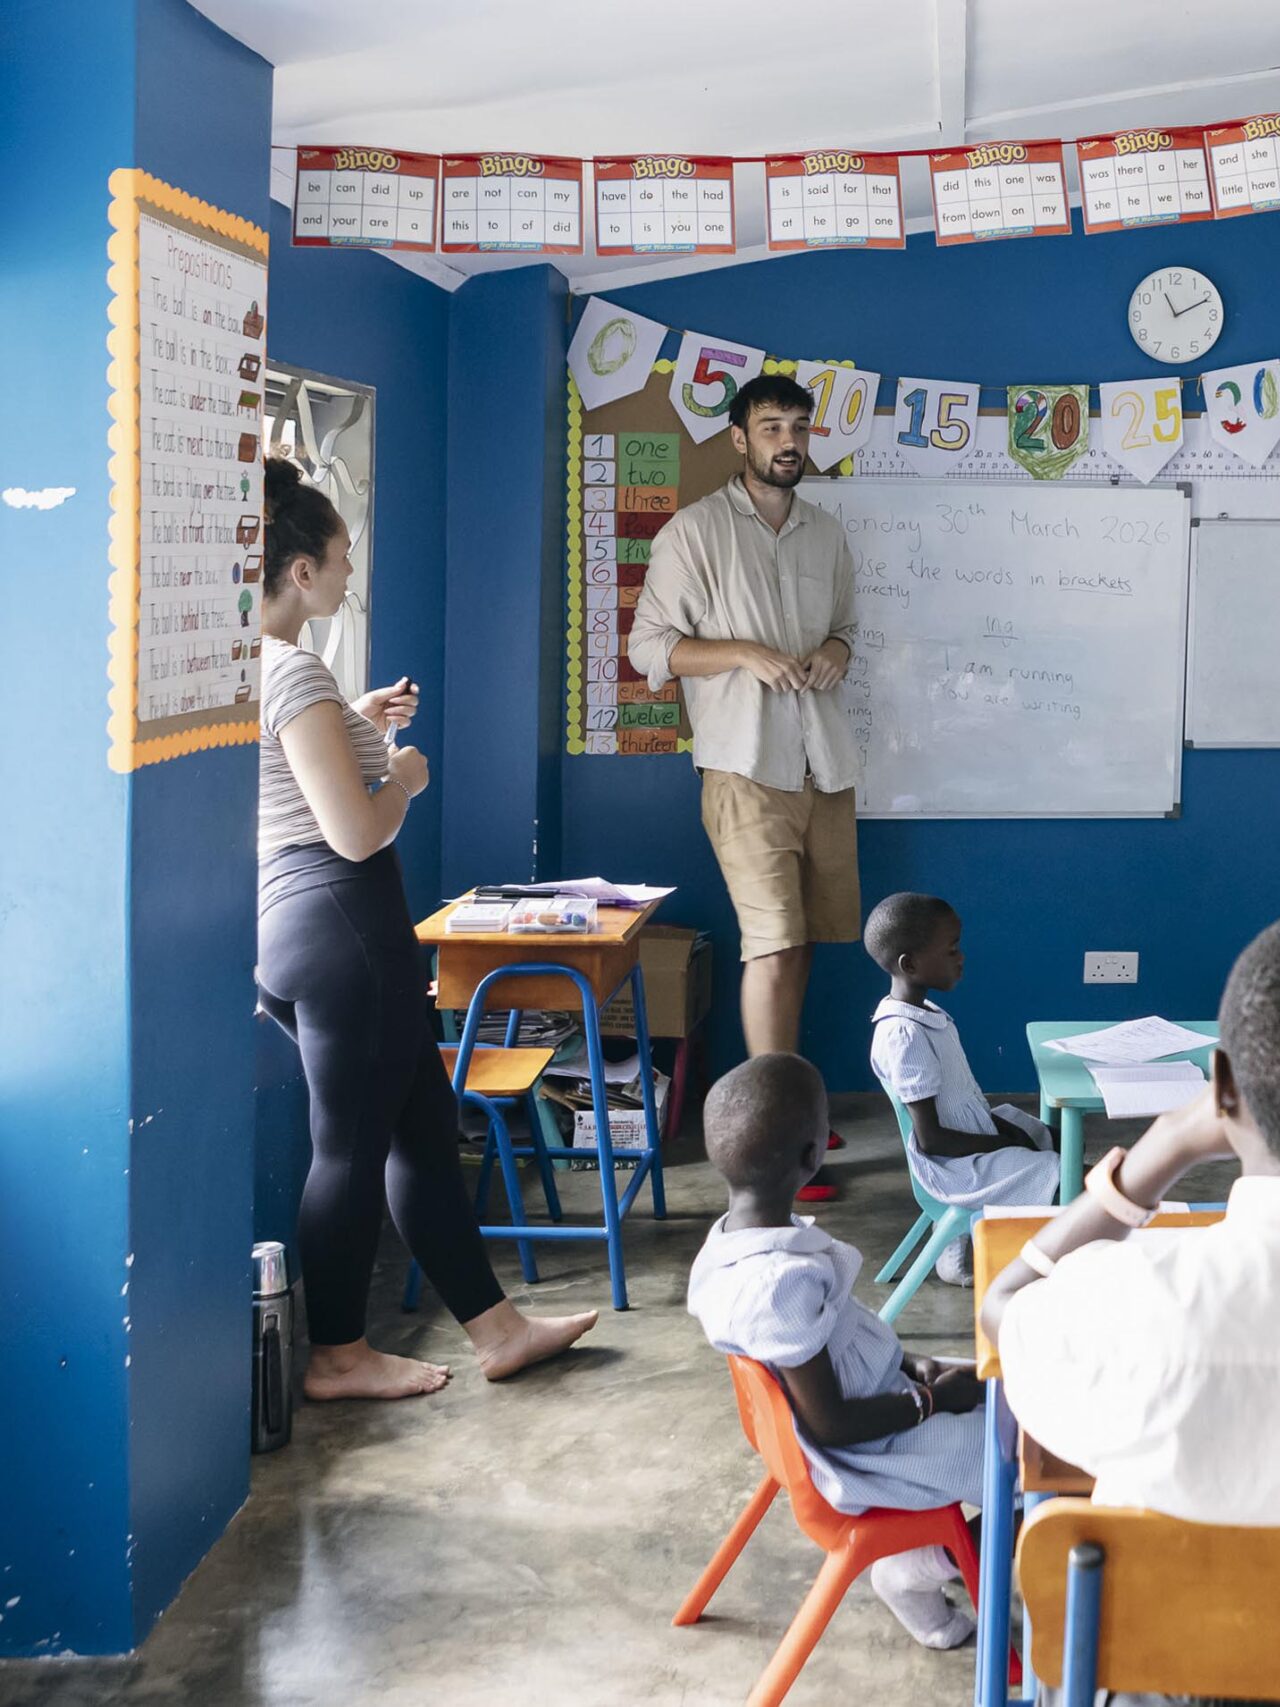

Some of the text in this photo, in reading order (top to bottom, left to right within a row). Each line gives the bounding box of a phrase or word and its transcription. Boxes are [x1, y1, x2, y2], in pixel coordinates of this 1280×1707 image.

[336, 150, 398, 170] Bingo
[804, 153, 864, 174] Bingo
[968, 145, 1025, 167] Bingo
[308, 182, 320, 192] be
[371, 184, 389, 194] did
[409, 190, 423, 200] up
[782, 183, 891, 196] is said for that
[943, 180, 959, 191] did
[974, 178, 991, 187] this
[303, 215, 322, 224] and
[332, 218, 357, 227] your
[369, 219, 388, 227] are
[782, 219, 792, 227] at
[814, 216, 826, 225] he
[846, 218, 859, 227] go
[943, 213, 966, 222] from
[972, 209, 1000, 220] down
[1043, 206, 1056, 214] my
[168, 235, 233, 290] Prepositions
[1152, 279, 1162, 291] 11
[1169, 273, 1182, 285] 12
[1137, 293, 1151, 305] 10
[1203, 290, 1211, 302] 2
[1133, 311, 1141, 322] 9
[1209, 309, 1217, 321] 3
[1139, 329, 1147, 341] 8
[1204, 327, 1212, 340] 4
[1153, 342, 1162, 354] 7
[1171, 346, 1179, 359] 6
[1190, 341, 1199, 353] 5
[682, 347, 747, 417] 5
[808, 370, 868, 436] 10
[1215, 367, 1279, 434] 30
[898, 388, 970, 450] 15
[1014, 391, 1081, 449] 20
[1111, 389, 1181, 449] 25
[592, 435, 669, 458] 1 one
[591, 462, 665, 485] 2 two
[591, 487, 669, 511] 3 three
[589, 512, 607, 534] 4
[936, 503, 986, 535] 30th
[1010, 509, 1081, 539] March
[1100, 515, 1171, 546] 2026
[593, 539, 652, 562] 5 fiv
[592, 562, 610, 583] 6
[907, 557, 942, 581] the
[955, 567, 1014, 586] words
[1030, 572, 1046, 587] in
[1058, 570, 1133, 593] brackets
[595, 587, 611, 605] 7
[855, 583, 911, 610] orrectly
[593, 611, 610, 633] 8
[595, 635, 609, 657] 9
[592, 658, 617, 680] 10
[965, 662, 1075, 693] am running
[593, 704, 674, 728] 12 twelve
[587, 733, 676, 753] 13 thirteen
